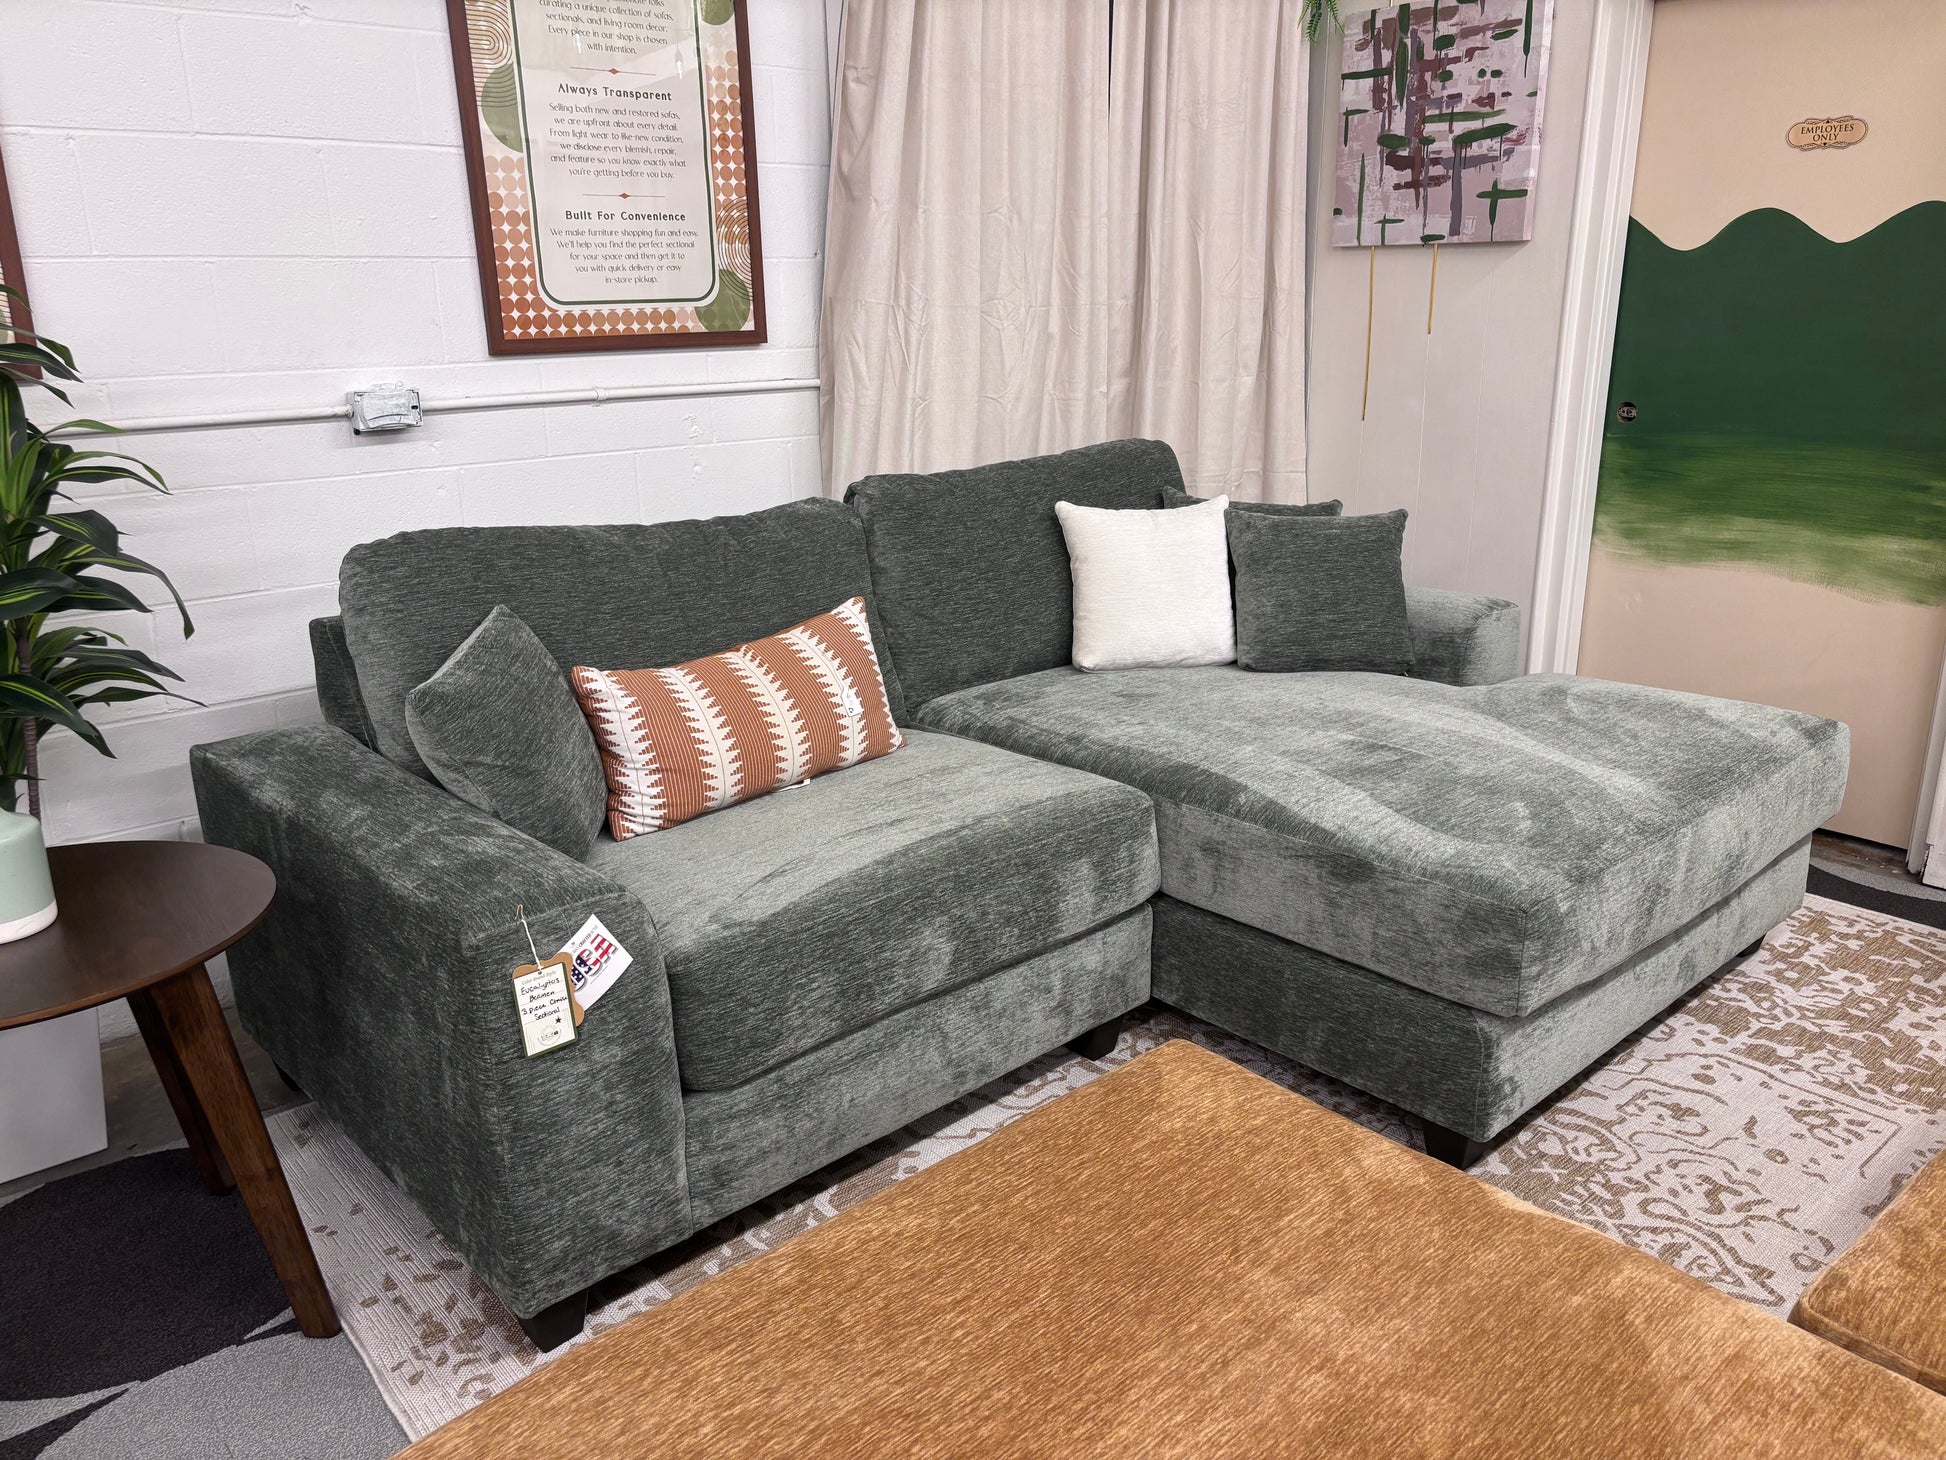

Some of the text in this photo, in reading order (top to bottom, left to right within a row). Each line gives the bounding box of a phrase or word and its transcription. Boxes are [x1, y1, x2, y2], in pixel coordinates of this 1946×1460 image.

[582, 4, 607, 13] unique
[609, 6, 642, 16] collection
[644, 10, 651, 18] of
[653, 11, 674, 21] sofas,
[546, 13, 668, 33] sectionals, and living room decor.
[548, 25, 568, 35] Every
[593, 30, 600, 38] in
[616, 32, 634, 43] shop
[643, 35, 668, 45] chosen
[587, 42, 637, 54] with intention.
[558, 83, 672, 101] Always Transparent
[549, 103, 680, 120] Selling both new and restored sofas,
[583, 118, 610, 128] upfront
[613, 120, 635, 129] about
[637, 122, 656, 131] every
[658, 122, 678, 131] detail.
[1801, 123, 1855, 134] EMPLOYEES
[550, 128, 570, 137] From
[572, 129, 588, 140] light
[611, 132, 619, 140] to
[621, 132, 649, 141] like-new
[651, 133, 684, 144] condition,
[1812, 133, 1839, 142] ONLY
[573, 142, 602, 152] disclose
[603, 145, 623, 153] every
[625, 144, 653, 154] blemish,
[654, 147, 677, 156] repair,
[550, 154, 566, 162] and
[568, 155, 595, 163] feature
[607, 157, 621, 165] you
[622, 157, 641, 165] know
[643, 158, 667, 167] exactly
[669, 159, 687, 167] what
[569, 167, 675, 179] you're getting before you buy.
[565, 210, 686, 221] Built For Convenience
[550, 228, 699, 238] We make furniture shopping fun and easy.
[556, 240, 575, 248] We'll
[576, 240, 592, 250] help
[609, 240, 623, 248] find
[625, 240, 637, 248] the
[638, 240, 664, 250] perfect
[665, 240, 695, 248] sectional
[570, 252, 580, 260] for
[583, 253, 599, 261] your
[602, 253, 623, 261] space
[625, 252, 639, 260] and
[641, 252, 656, 260] then
[658, 253, 670, 261] get
[671, 252, 676, 260] it
[574, 265, 588, 273] you
[590, 264, 606, 272] with
[608, 264, 627, 273] quick
[628, 264, 654, 273] delivery
[605, 275, 658, 284] in-store pickup.
[534, 1006, 560, 1021] Sectional
